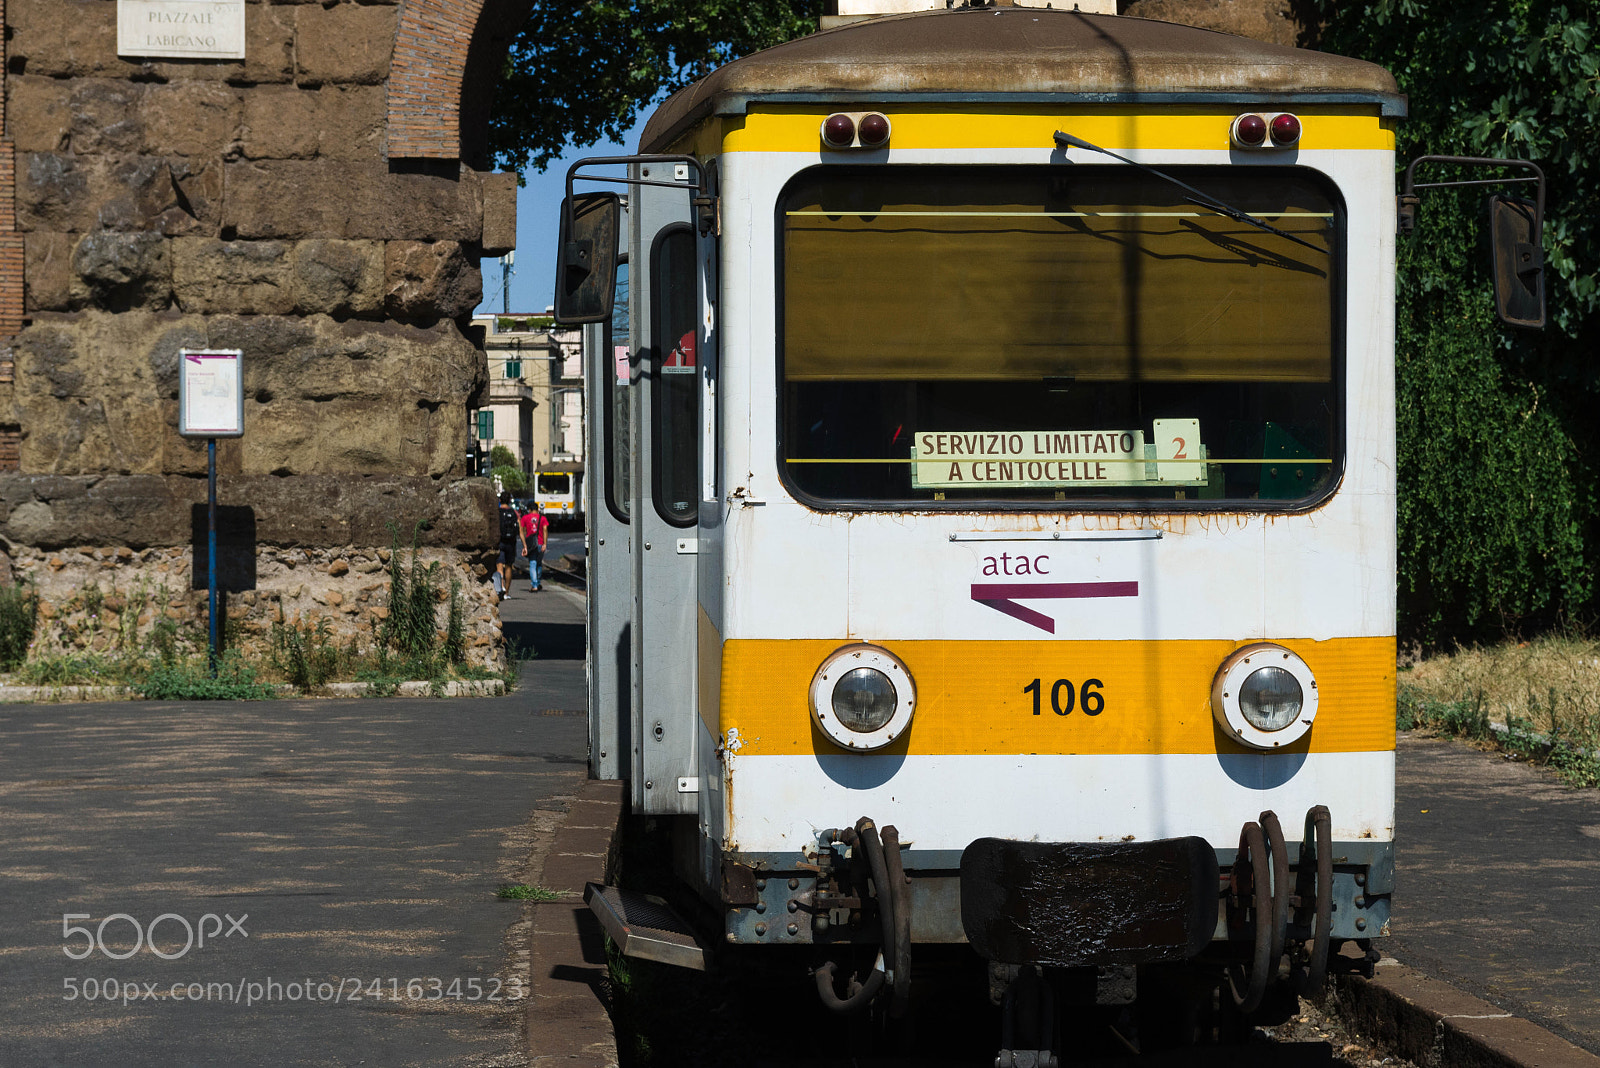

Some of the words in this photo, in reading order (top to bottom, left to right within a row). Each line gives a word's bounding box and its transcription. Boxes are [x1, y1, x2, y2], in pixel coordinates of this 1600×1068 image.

[148, 11, 214, 24] PIAZZALE
[146, 34, 216, 47] LABICANO
[922, 434, 1024, 455] SERVIZIO
[1033, 433, 1135, 454] LIMITATO
[1171, 437, 1188, 459] 2
[948, 461, 963, 481] A
[971, 461, 1107, 481] CENTOCELLE
[982, 552, 1050, 576] atac
[1023, 678, 1105, 716] 106
